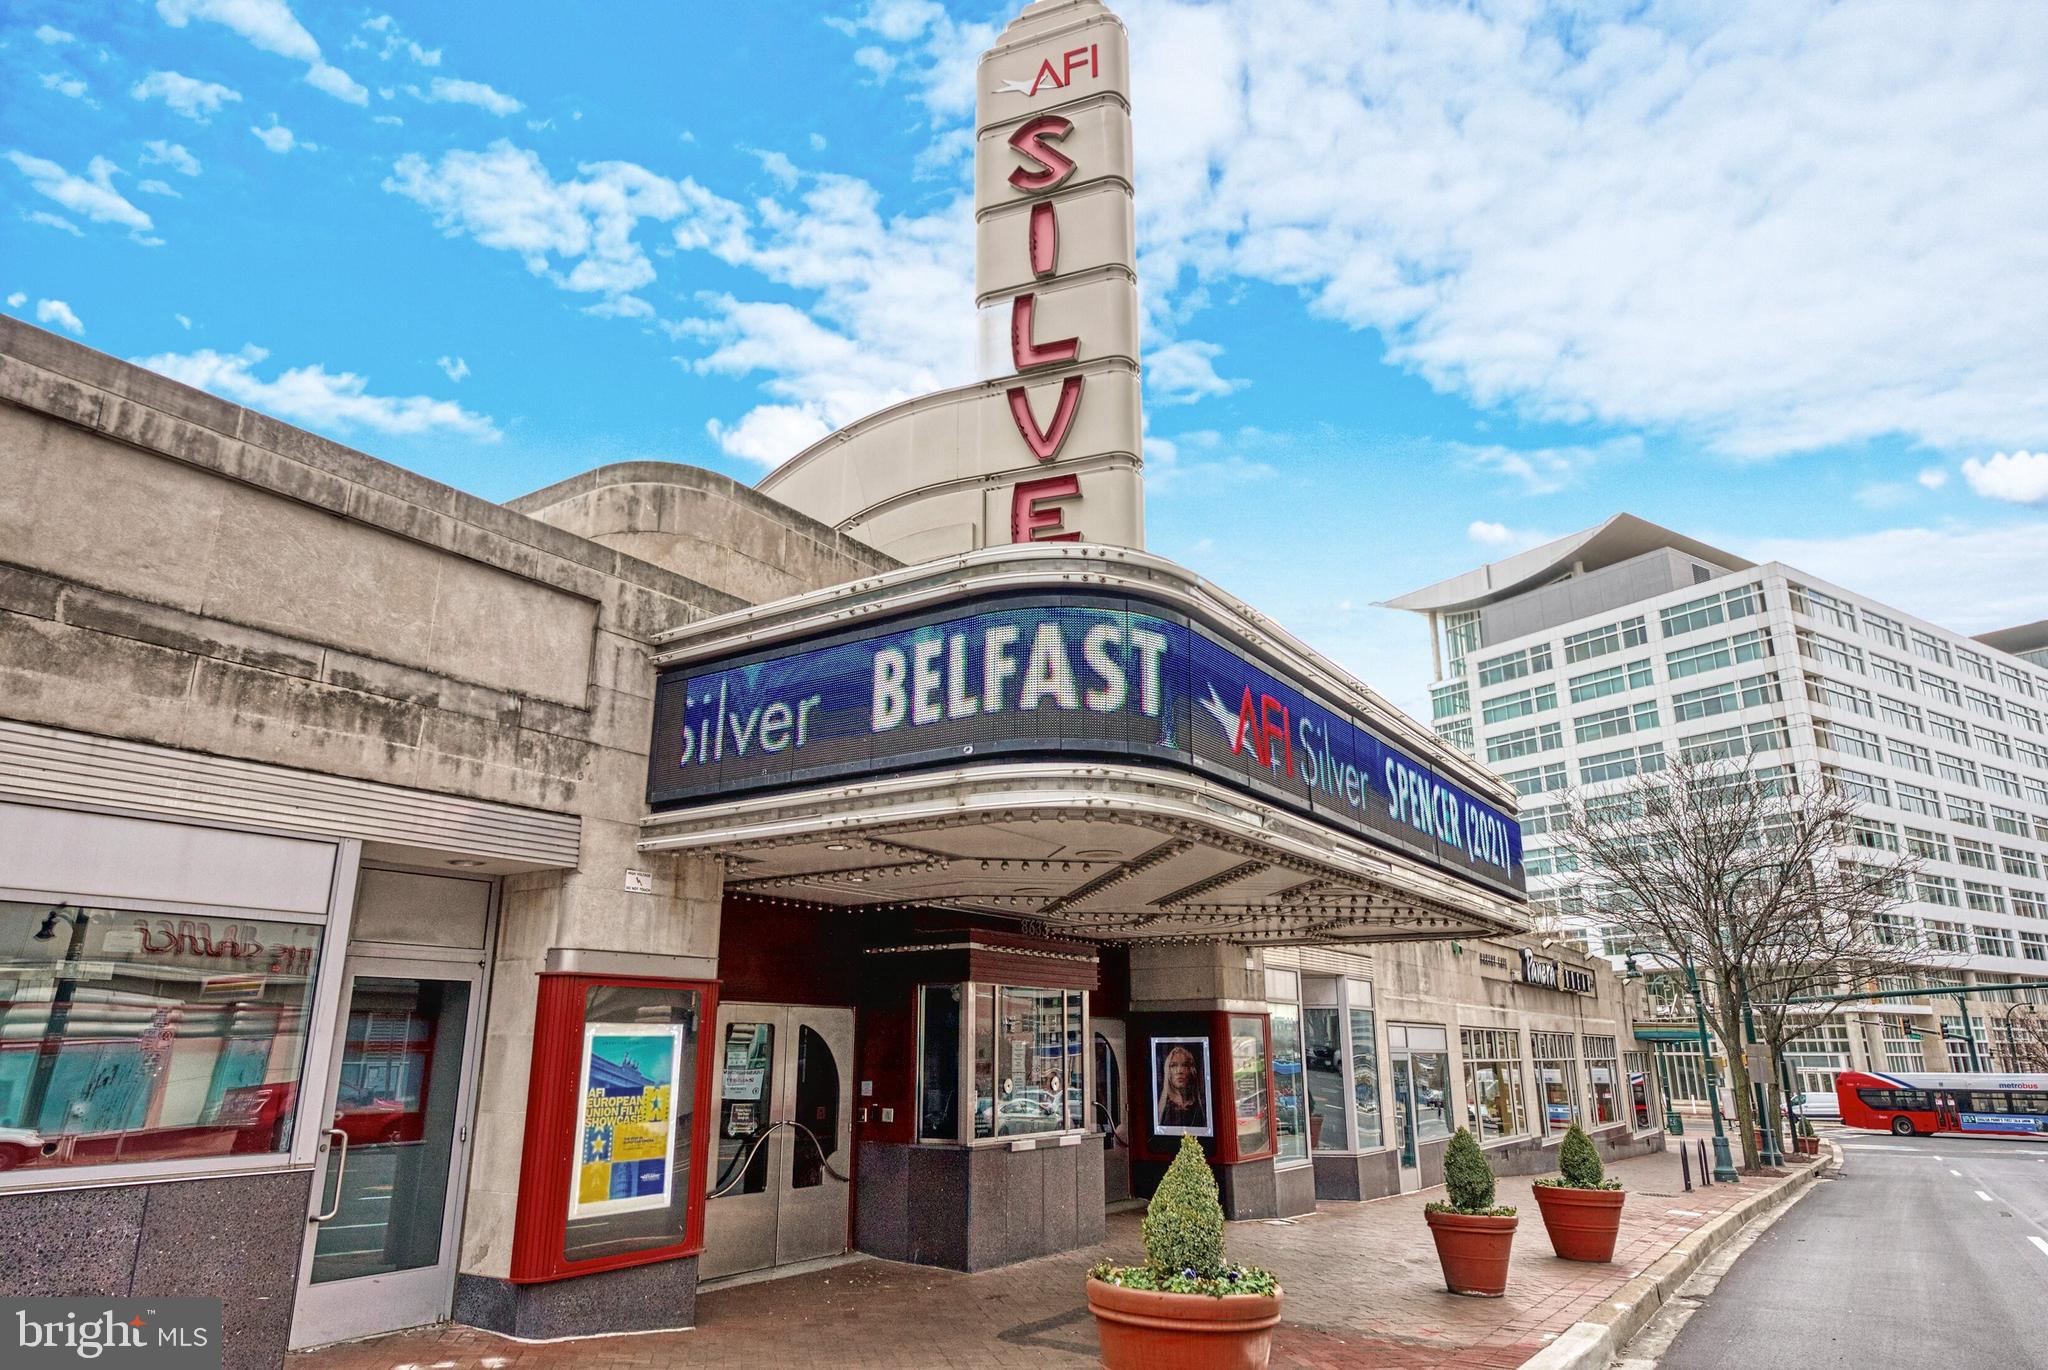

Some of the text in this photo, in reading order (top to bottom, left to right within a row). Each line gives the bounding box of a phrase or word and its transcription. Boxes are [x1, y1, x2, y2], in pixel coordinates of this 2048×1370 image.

[1030, 43, 1099, 97] AFI
[871, 623, 1168, 733] BELFAST
[1232, 683, 1512, 880] AFI Silver SPENCER (2021)
[1521, 947, 1557, 988] Panera
[586, 1096, 644, 1108] EUROPEAN
[588, 1087, 606, 1098] AFI
[584, 1114, 643, 1127] SHOWCASE
[585, 1105, 644, 1118] UNION FILM
